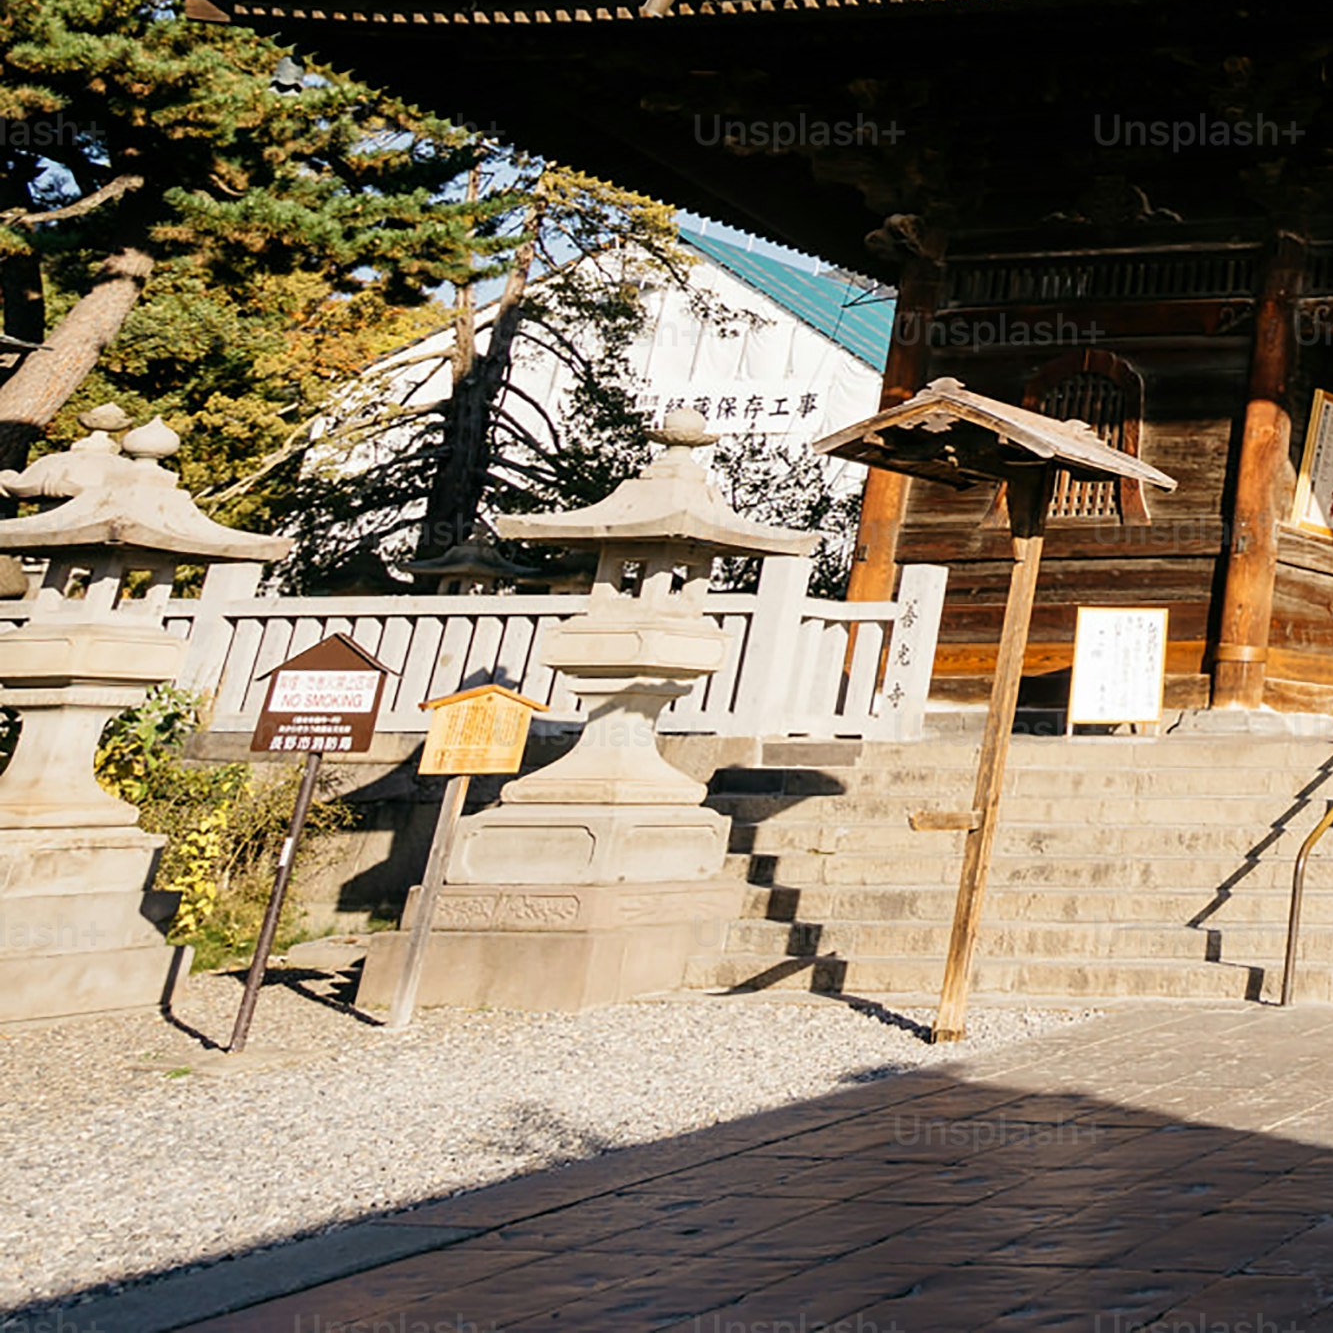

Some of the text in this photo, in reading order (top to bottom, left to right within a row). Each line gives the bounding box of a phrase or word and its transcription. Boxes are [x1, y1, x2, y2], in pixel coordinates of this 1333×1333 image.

[887, 599, 919, 708] 善光寺
[281, 693, 363, 708] NO SMOKING
